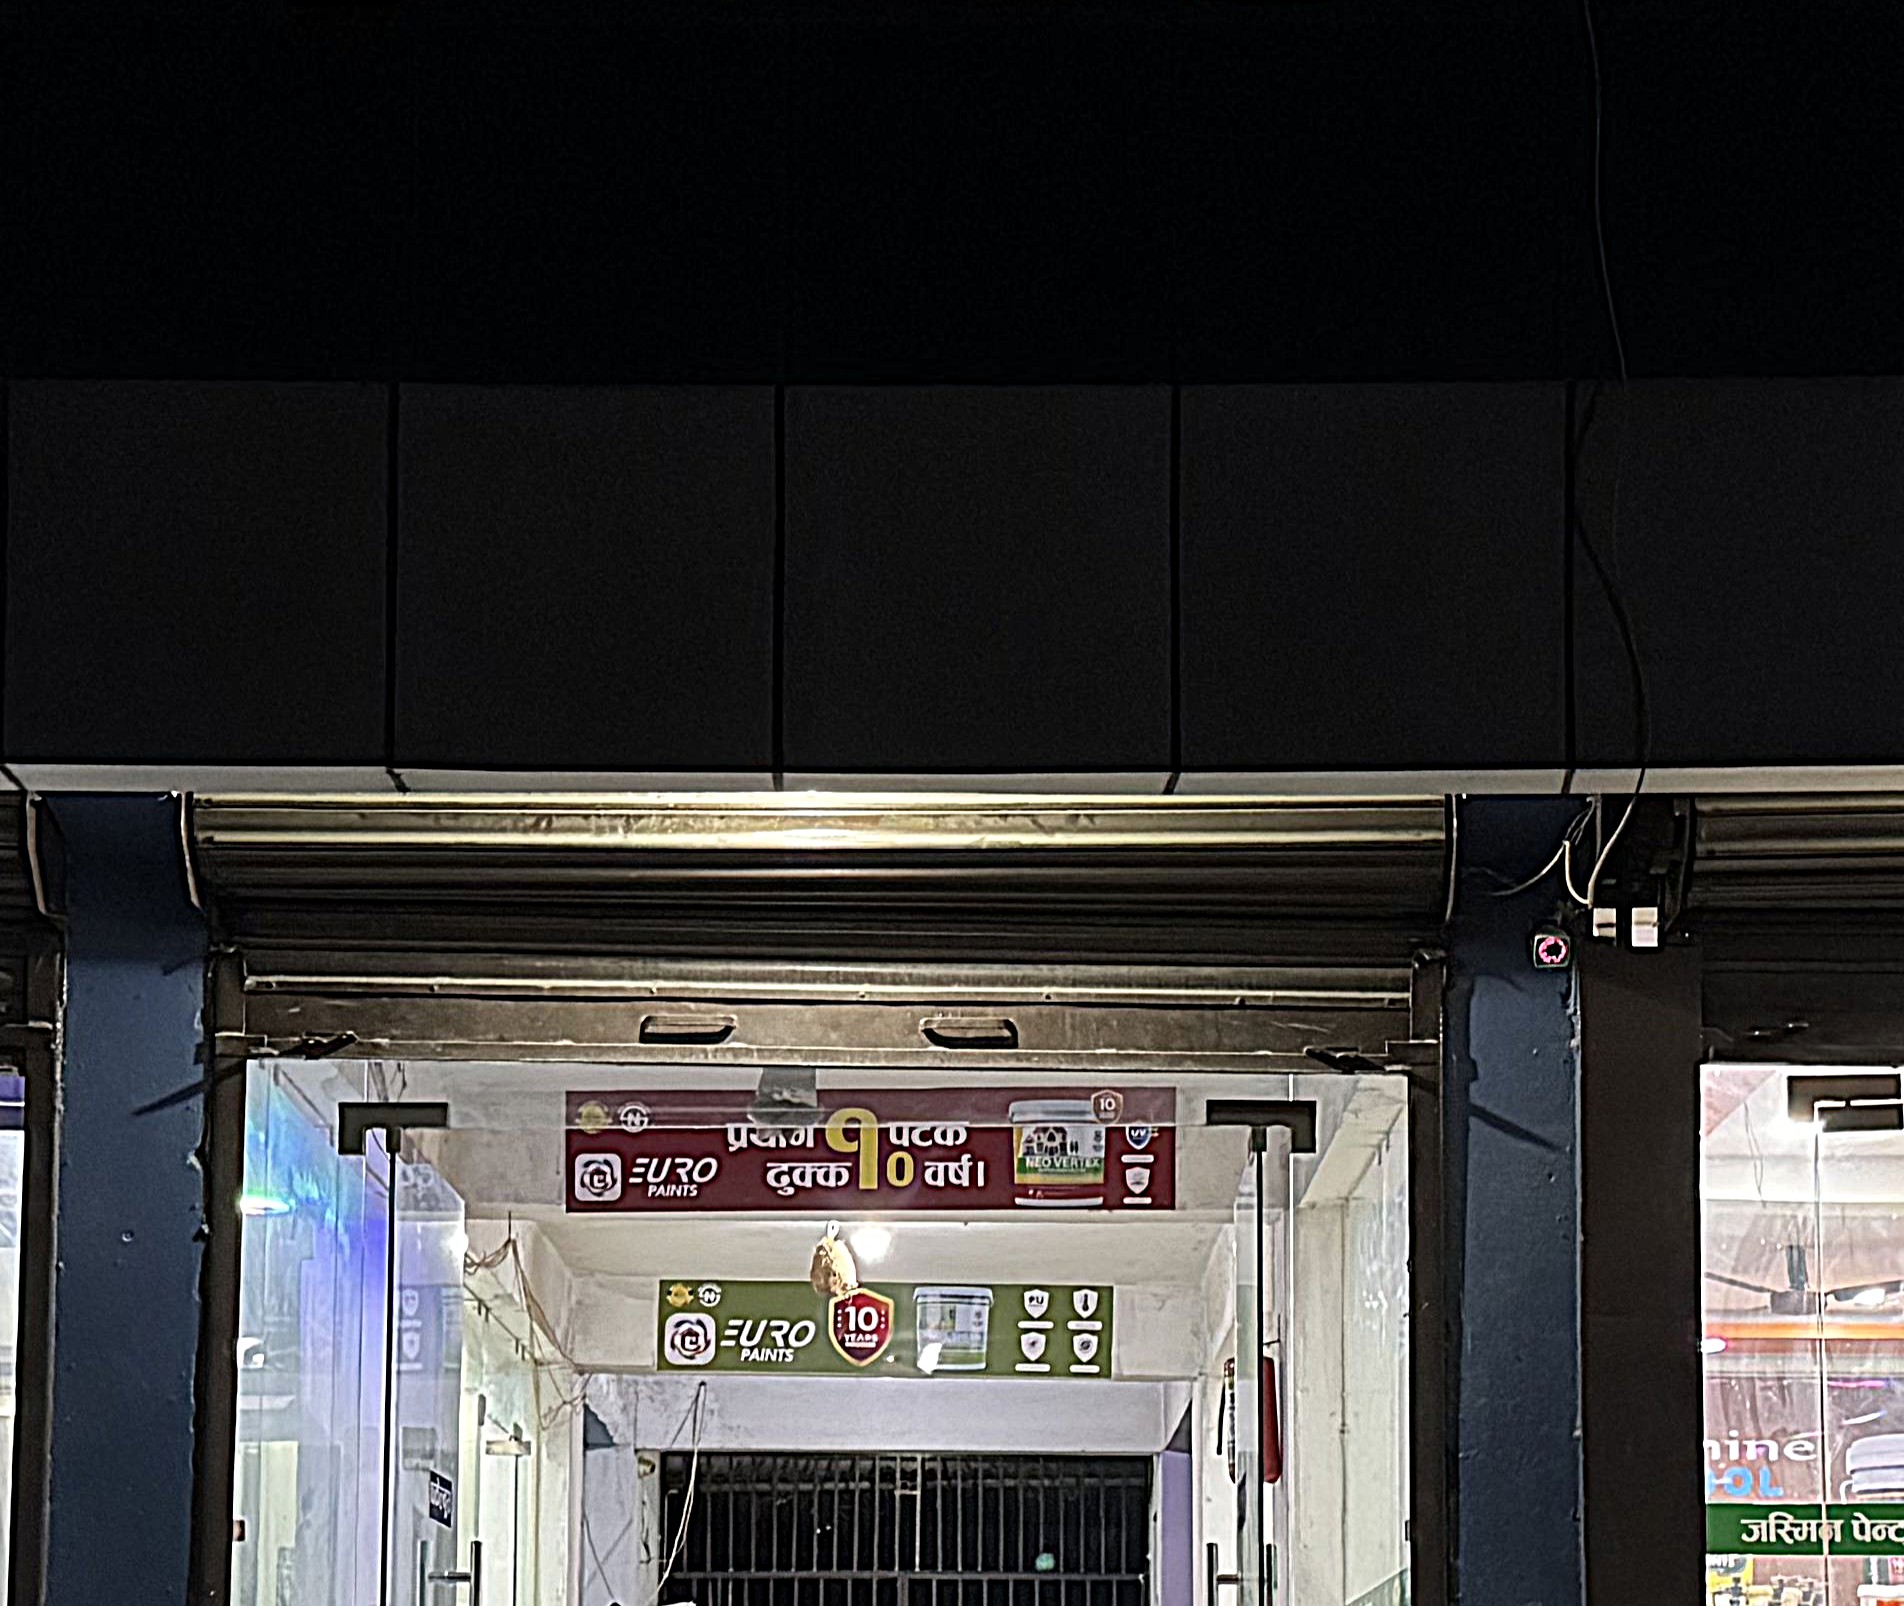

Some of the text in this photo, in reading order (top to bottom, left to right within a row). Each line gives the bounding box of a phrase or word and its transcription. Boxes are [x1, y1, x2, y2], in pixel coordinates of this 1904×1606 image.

[1099, 1098, 1115, 1111] 10
[628, 1157, 718, 1183] EURO
[648, 1184, 698, 1197] PAINTS
[844, 1306, 879, 1332] 10
[720, 1319, 817, 1348] EURO
[844, 1334, 878, 1343] YEARS
[740, 1349, 794, 1362] PAINTS
